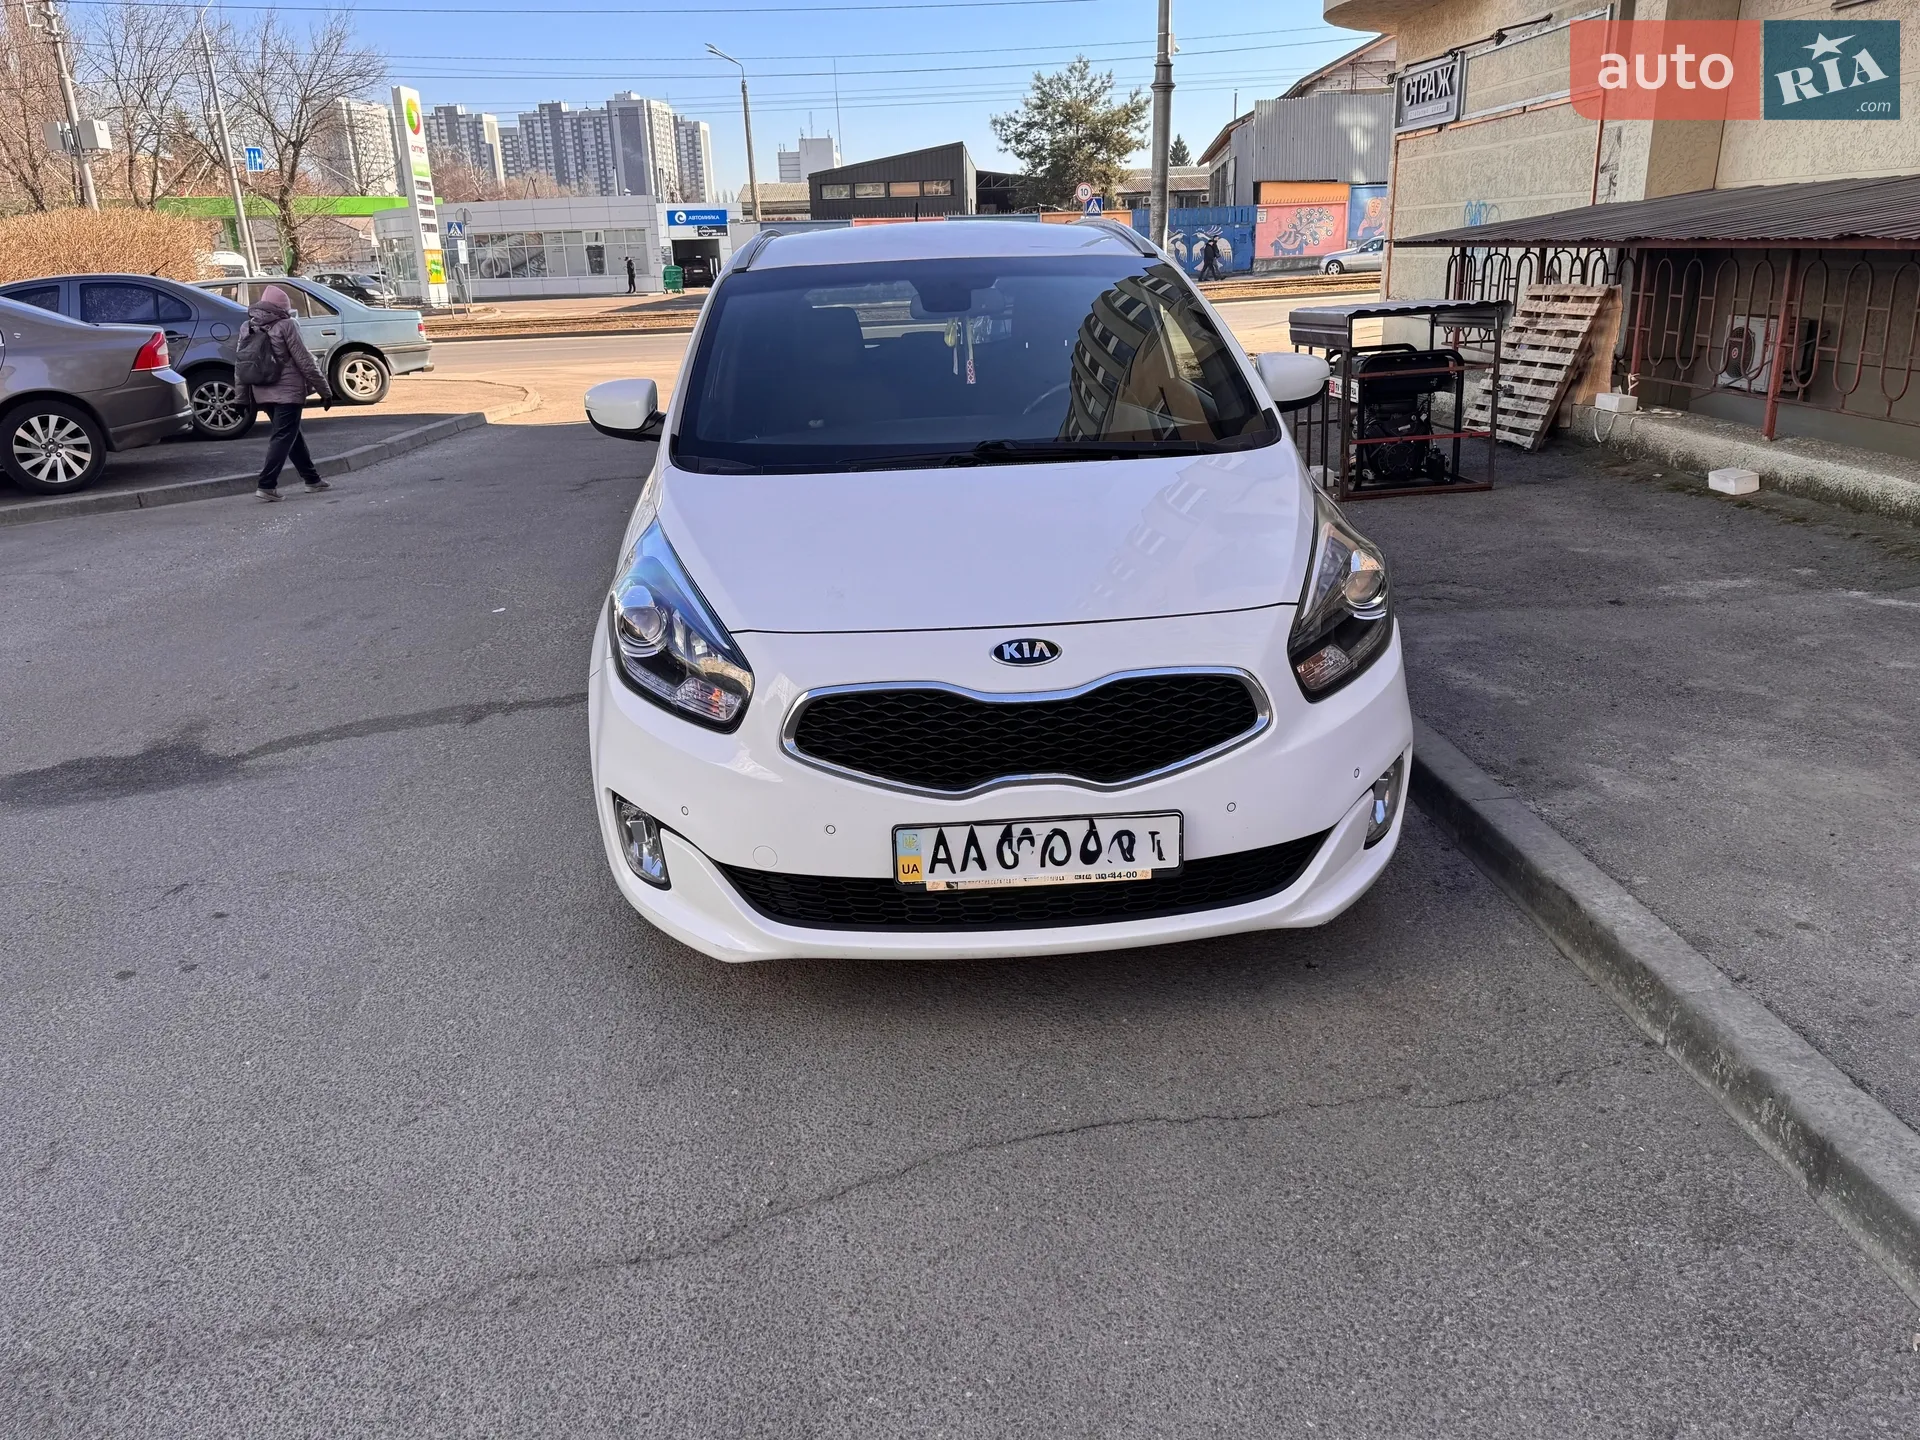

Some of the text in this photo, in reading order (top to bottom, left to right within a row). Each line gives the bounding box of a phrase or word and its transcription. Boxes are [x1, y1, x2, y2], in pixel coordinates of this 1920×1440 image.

[1404, 64, 1455, 106] СТРАЖ
[1080, 188, 1088, 196] 10
[1002, 641, 1052, 660] KIA
[902, 863, 920, 875] UA
